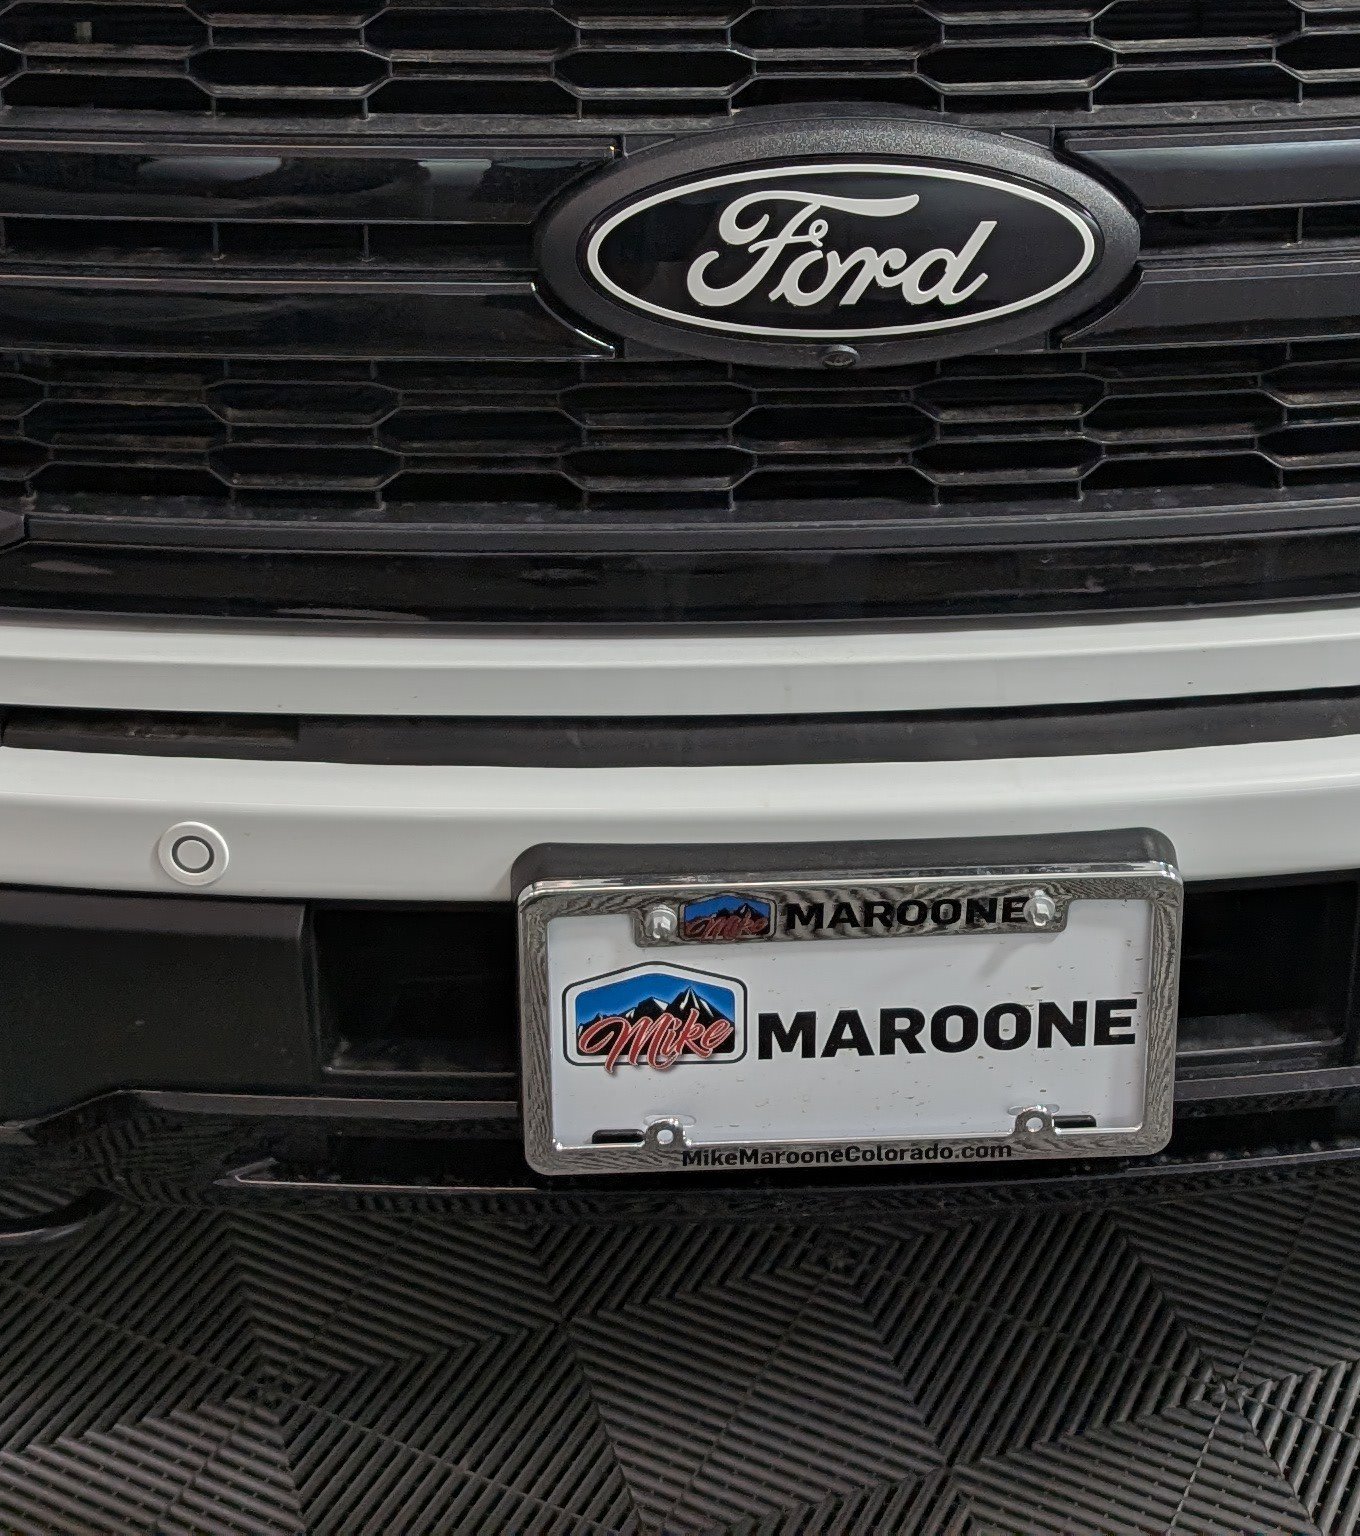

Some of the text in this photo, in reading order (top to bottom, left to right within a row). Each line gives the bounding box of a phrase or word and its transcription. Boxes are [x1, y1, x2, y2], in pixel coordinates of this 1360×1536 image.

[687, 190, 997, 306] Ford
[685, 896, 1031, 943] Mike MAROONE
[578, 998, 1138, 1074] Mike MAROONE
[682, 1142, 1013, 1167] MikeMarooneColorado.com
